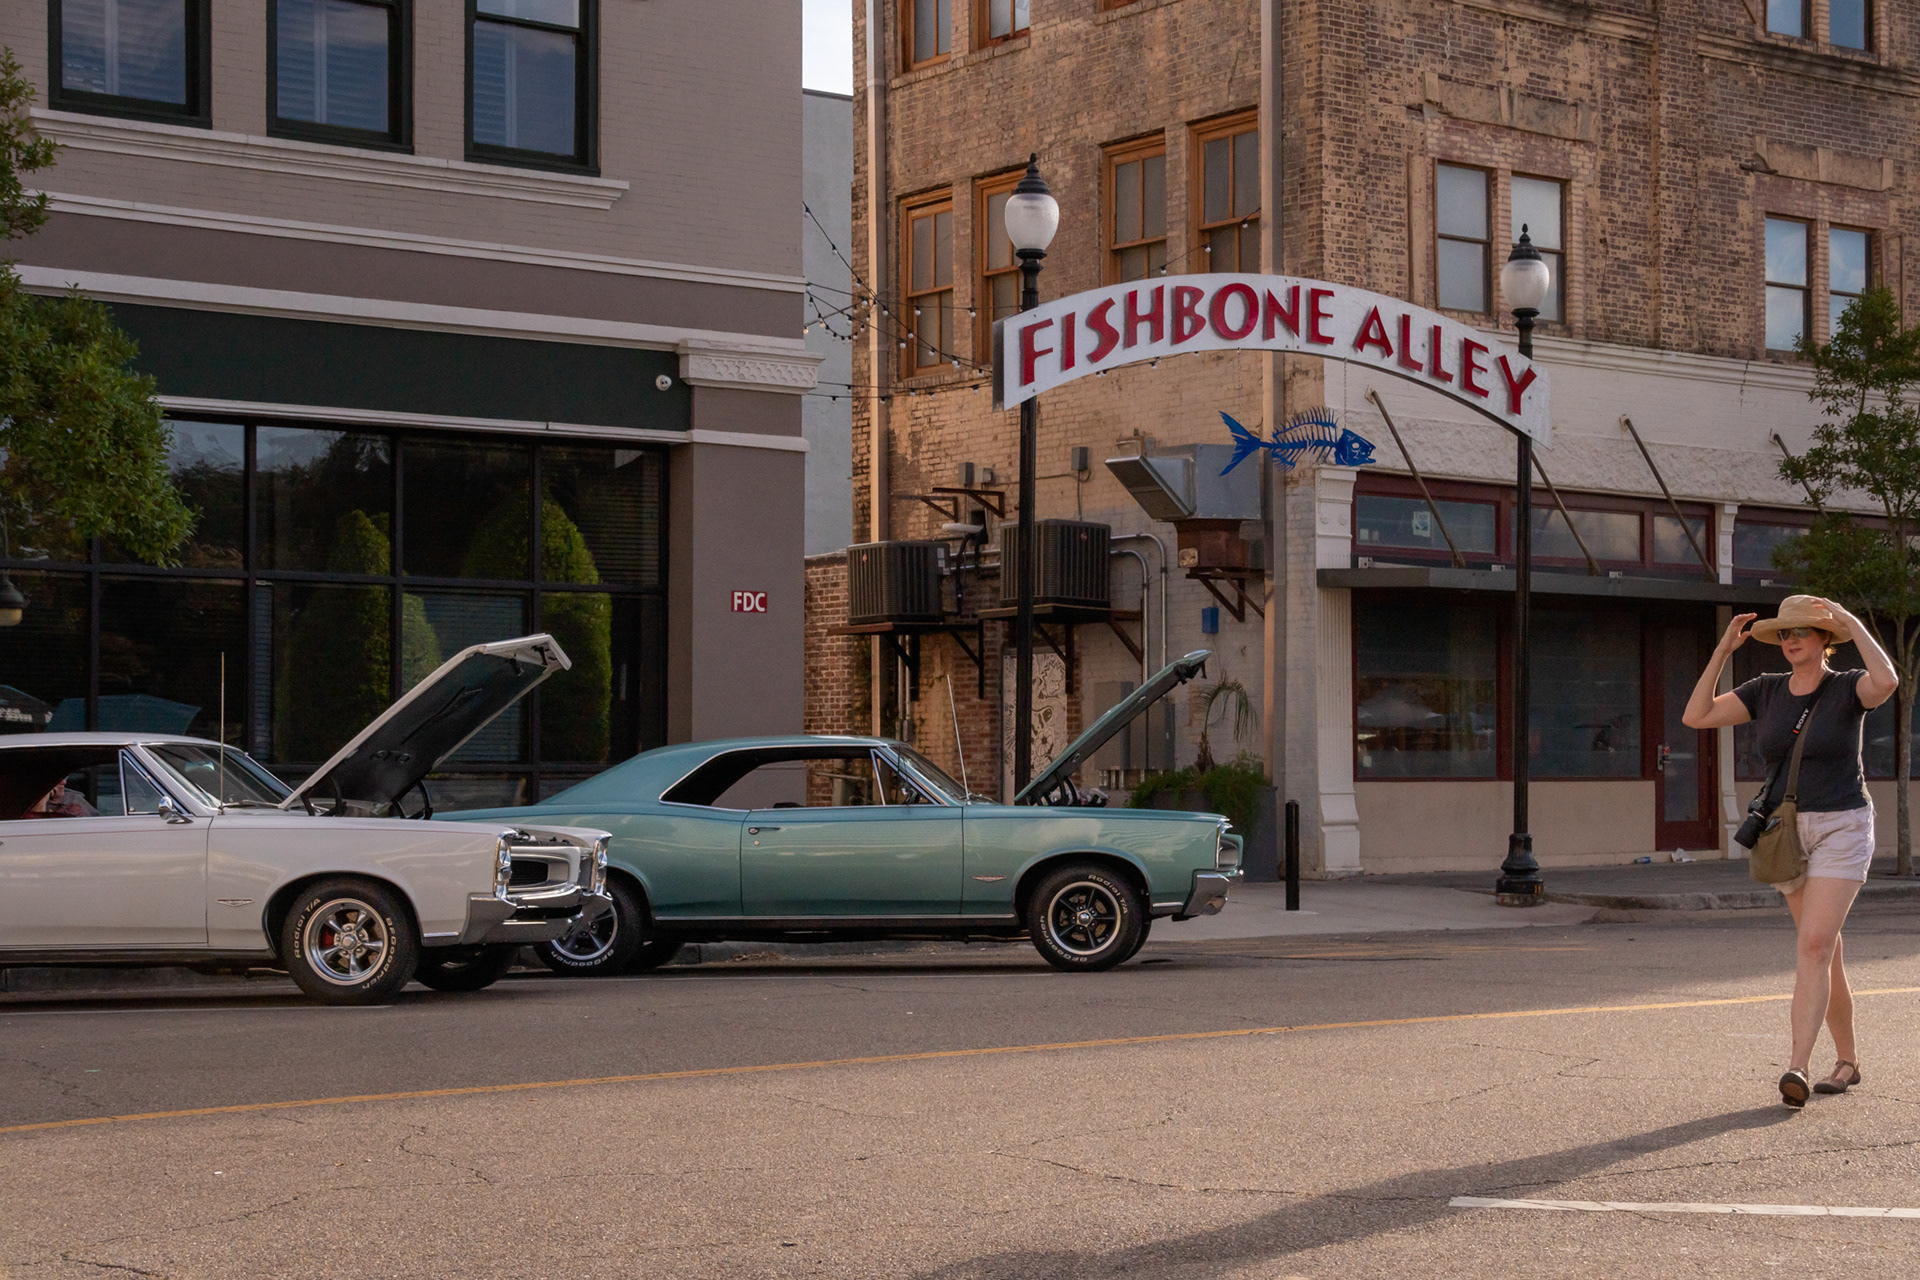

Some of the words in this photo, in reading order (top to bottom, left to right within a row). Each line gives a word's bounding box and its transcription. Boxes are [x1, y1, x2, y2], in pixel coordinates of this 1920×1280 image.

[1021, 283, 1335, 386] FISHBONE
[1355, 305, 1537, 415] ALLEY
[733, 591, 766, 612] FDC
[1795, 708, 1809, 730] SONY
[1088, 874, 1121, 896] Radial
[1120, 897, 1129, 914] T/A
[294, 915, 306, 958] Radial
[305, 898, 321, 913] T/A
[1040, 915, 1088, 962] BFGoodrich
[362, 917, 397, 989] BFGoodrich
[551, 949, 614, 967] BFGoodrich
